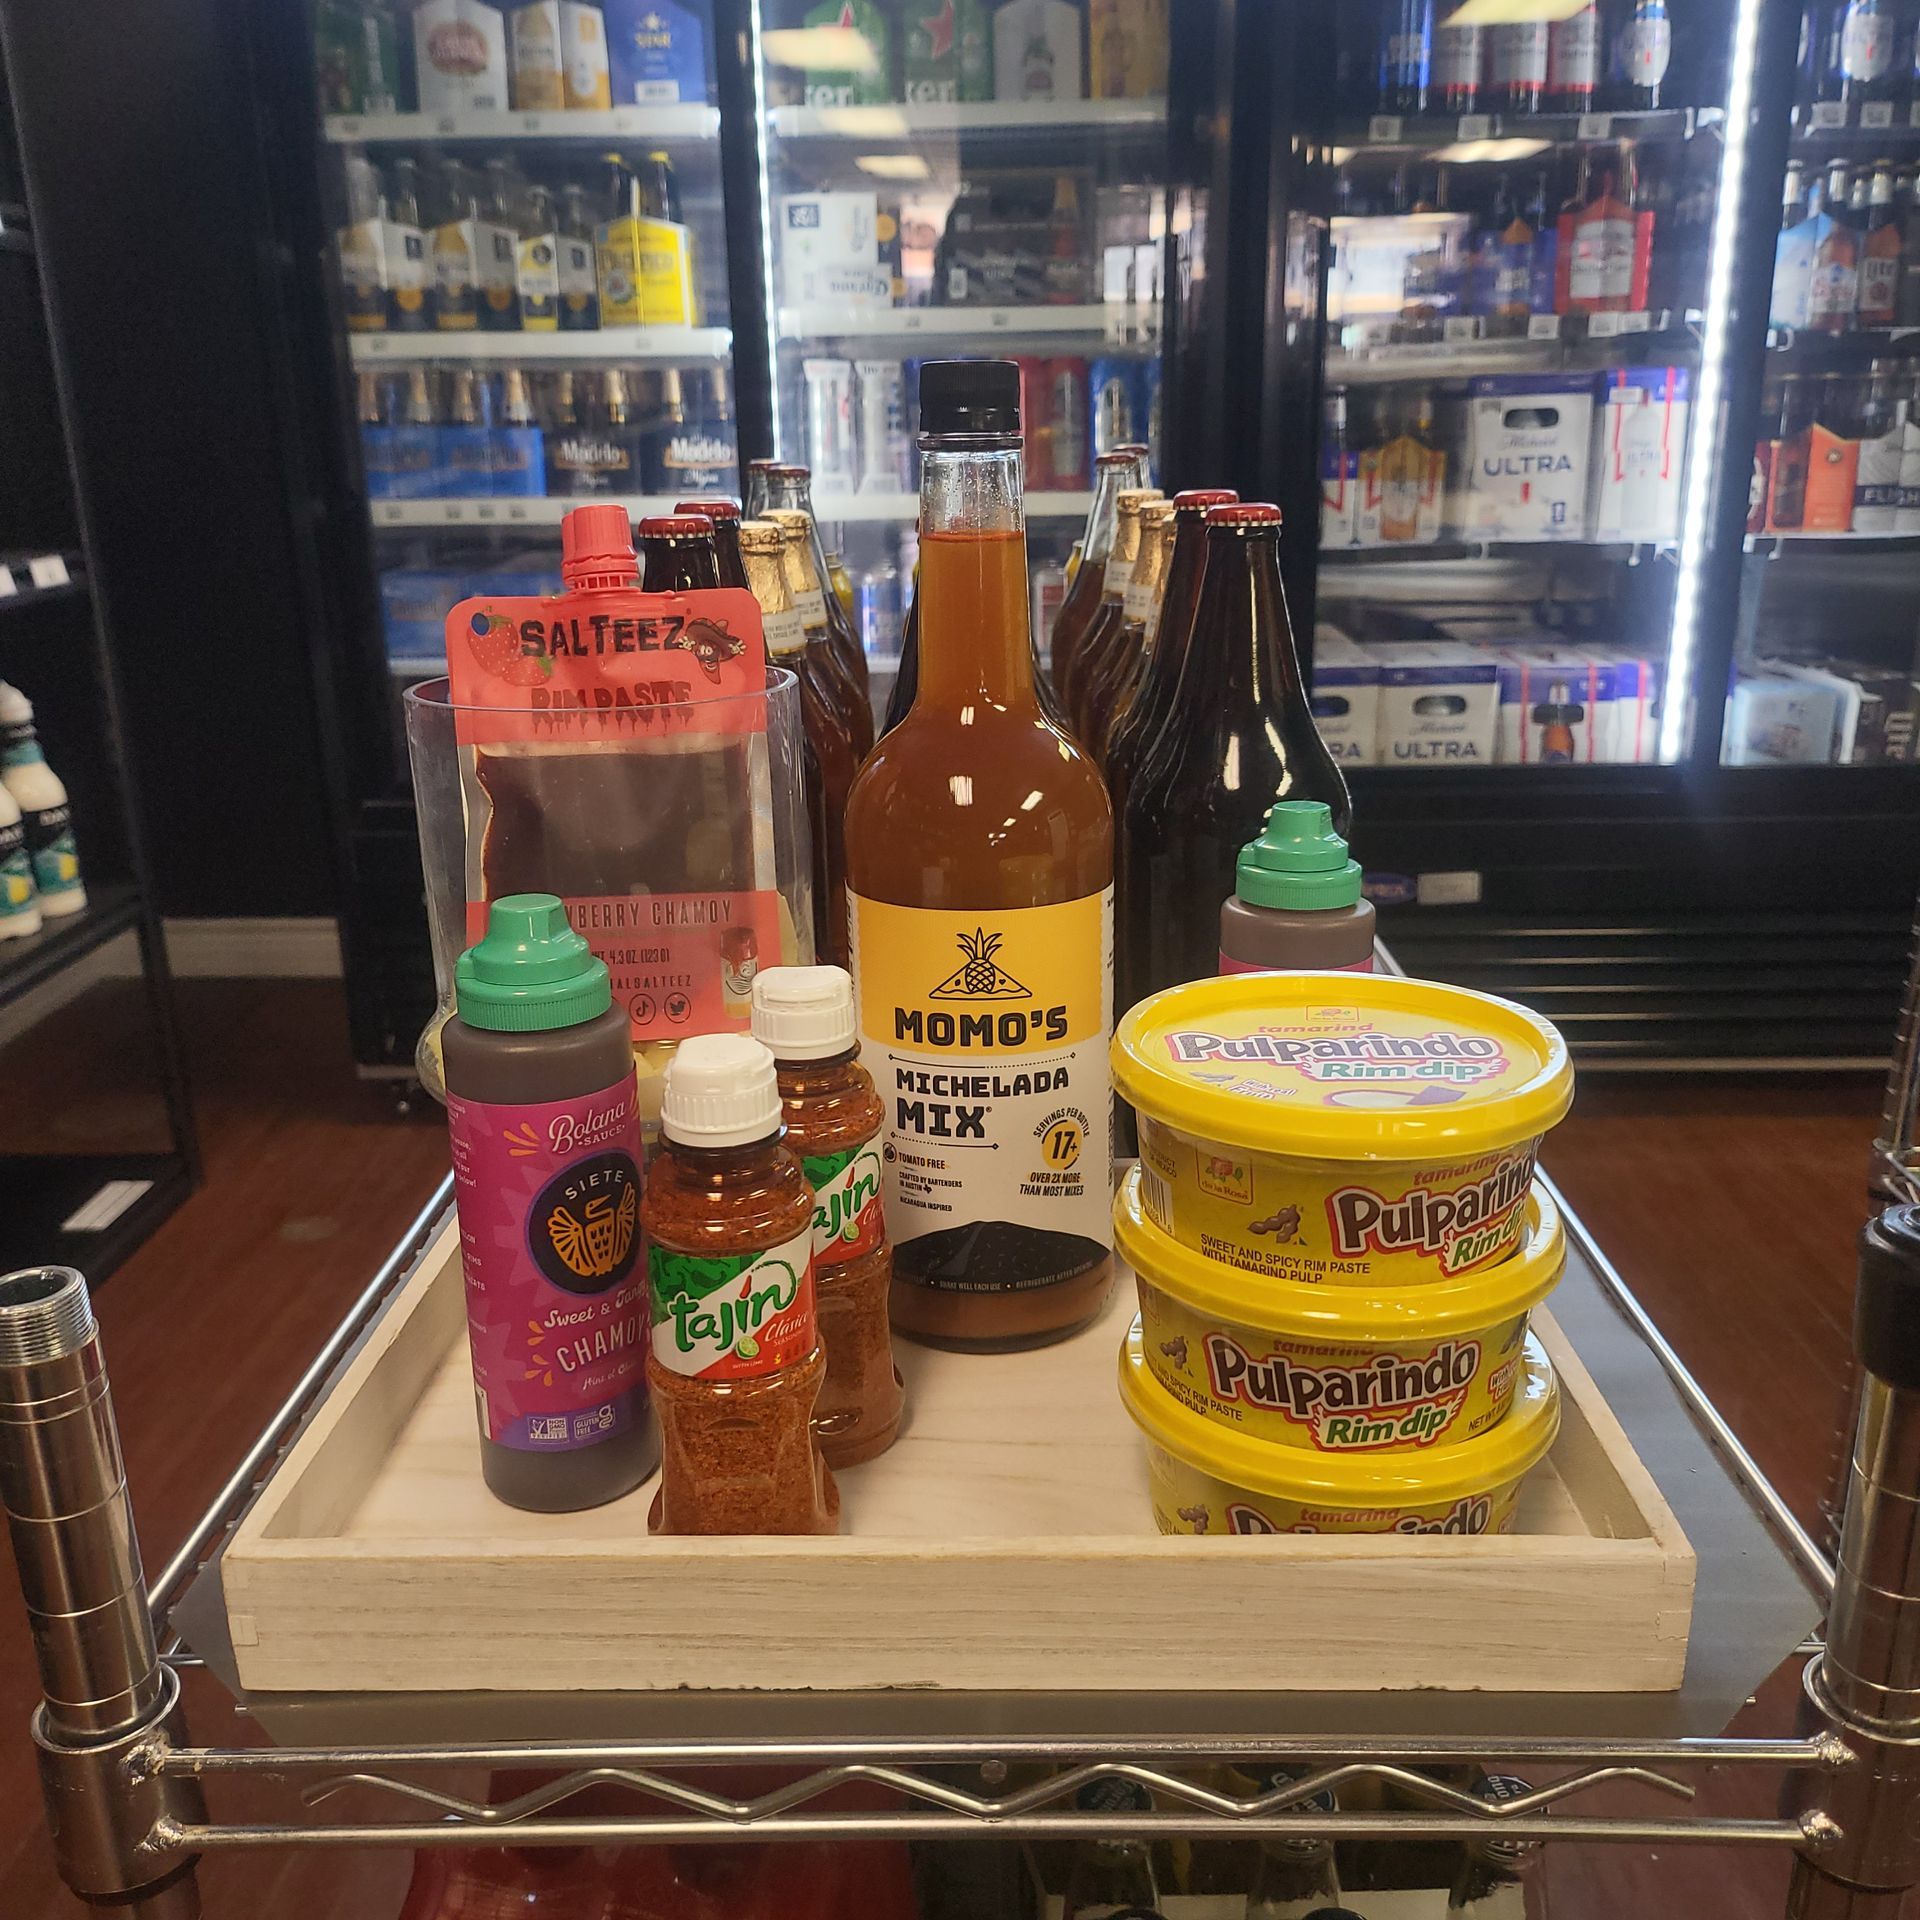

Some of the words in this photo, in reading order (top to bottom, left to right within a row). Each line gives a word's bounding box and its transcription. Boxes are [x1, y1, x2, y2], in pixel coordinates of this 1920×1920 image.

[1484, 455, 1573, 477] ULTRA
[520, 614, 685, 658] SALTEEZ
[531, 687, 589, 735] RIM
[593, 680, 695, 736] PASTE
[1394, 741, 1481, 760] ULTRA
[652, 899, 732, 927] CHAMOY
[895, 1005, 1068, 1047] MOMO'S
[1257, 1022, 1374, 1034] tamarind
[1178, 1033, 1495, 1062] Pulparindo
[896, 1066, 1070, 1098] MICHELADA
[1320, 1062, 1407, 1079] Rim
[1415, 1060, 1483, 1082] dip
[897, 1096, 985, 1139] MIX
[1032, 1107, 1065, 1138] SERVINGS
[1066, 1106, 1079, 1118] PER
[583, 1124, 622, 1146] SAUCE
[1052, 1130, 1078, 1160] 17+
[899, 1151, 926, 1167] TOMATO
[926, 1158, 946, 1170] FREE
[565, 1169, 624, 1200] SIETE
[899, 1171, 920, 1183] CRAFTED
[927, 1177, 963, 1188] BARTENDERS
[1020, 1183, 1042, 1196] THAN
[1042, 1185, 1064, 1197] MOST
[1064, 1184, 1084, 1197] MIXES
[1030, 1171, 1051, 1183] OVER
[1051, 1172, 1062, 1184] 2X
[1062, 1172, 1081, 1184] MORE
[927, 1202, 953, 1212] INSPIRED
[1200, 1233, 1236, 1253] SWEET
[1238, 1246, 1263, 1263] AND
[1265, 1252, 1302, 1270] SPICY
[1303, 1259, 1327, 1273] RIM
[1329, 1261, 1372, 1275] PASTE
[1451, 1223, 1500, 1268] Rim
[1201, 1245, 1227, 1265] WITH
[1228, 1255, 1288, 1281] TAMARIND
[1289, 1270, 1323, 1284] PULP
[958, 1282, 974, 1290] WELL
[974, 1282, 990, 1291] EACH
[543, 1305, 596, 1329] Sweet
[600, 1302, 612, 1315] &
[556, 1312, 646, 1372] CHAMOY
[1211, 1338, 1477, 1416] Pulparindo
[1185, 1397, 1207, 1416] PULP
[1192, 1389, 1209, 1407] RIM
[1210, 1399, 1243, 1422] PASTE
[1325, 1417, 1394, 1445] Rim
[1399, 1405, 1448, 1439] dip
